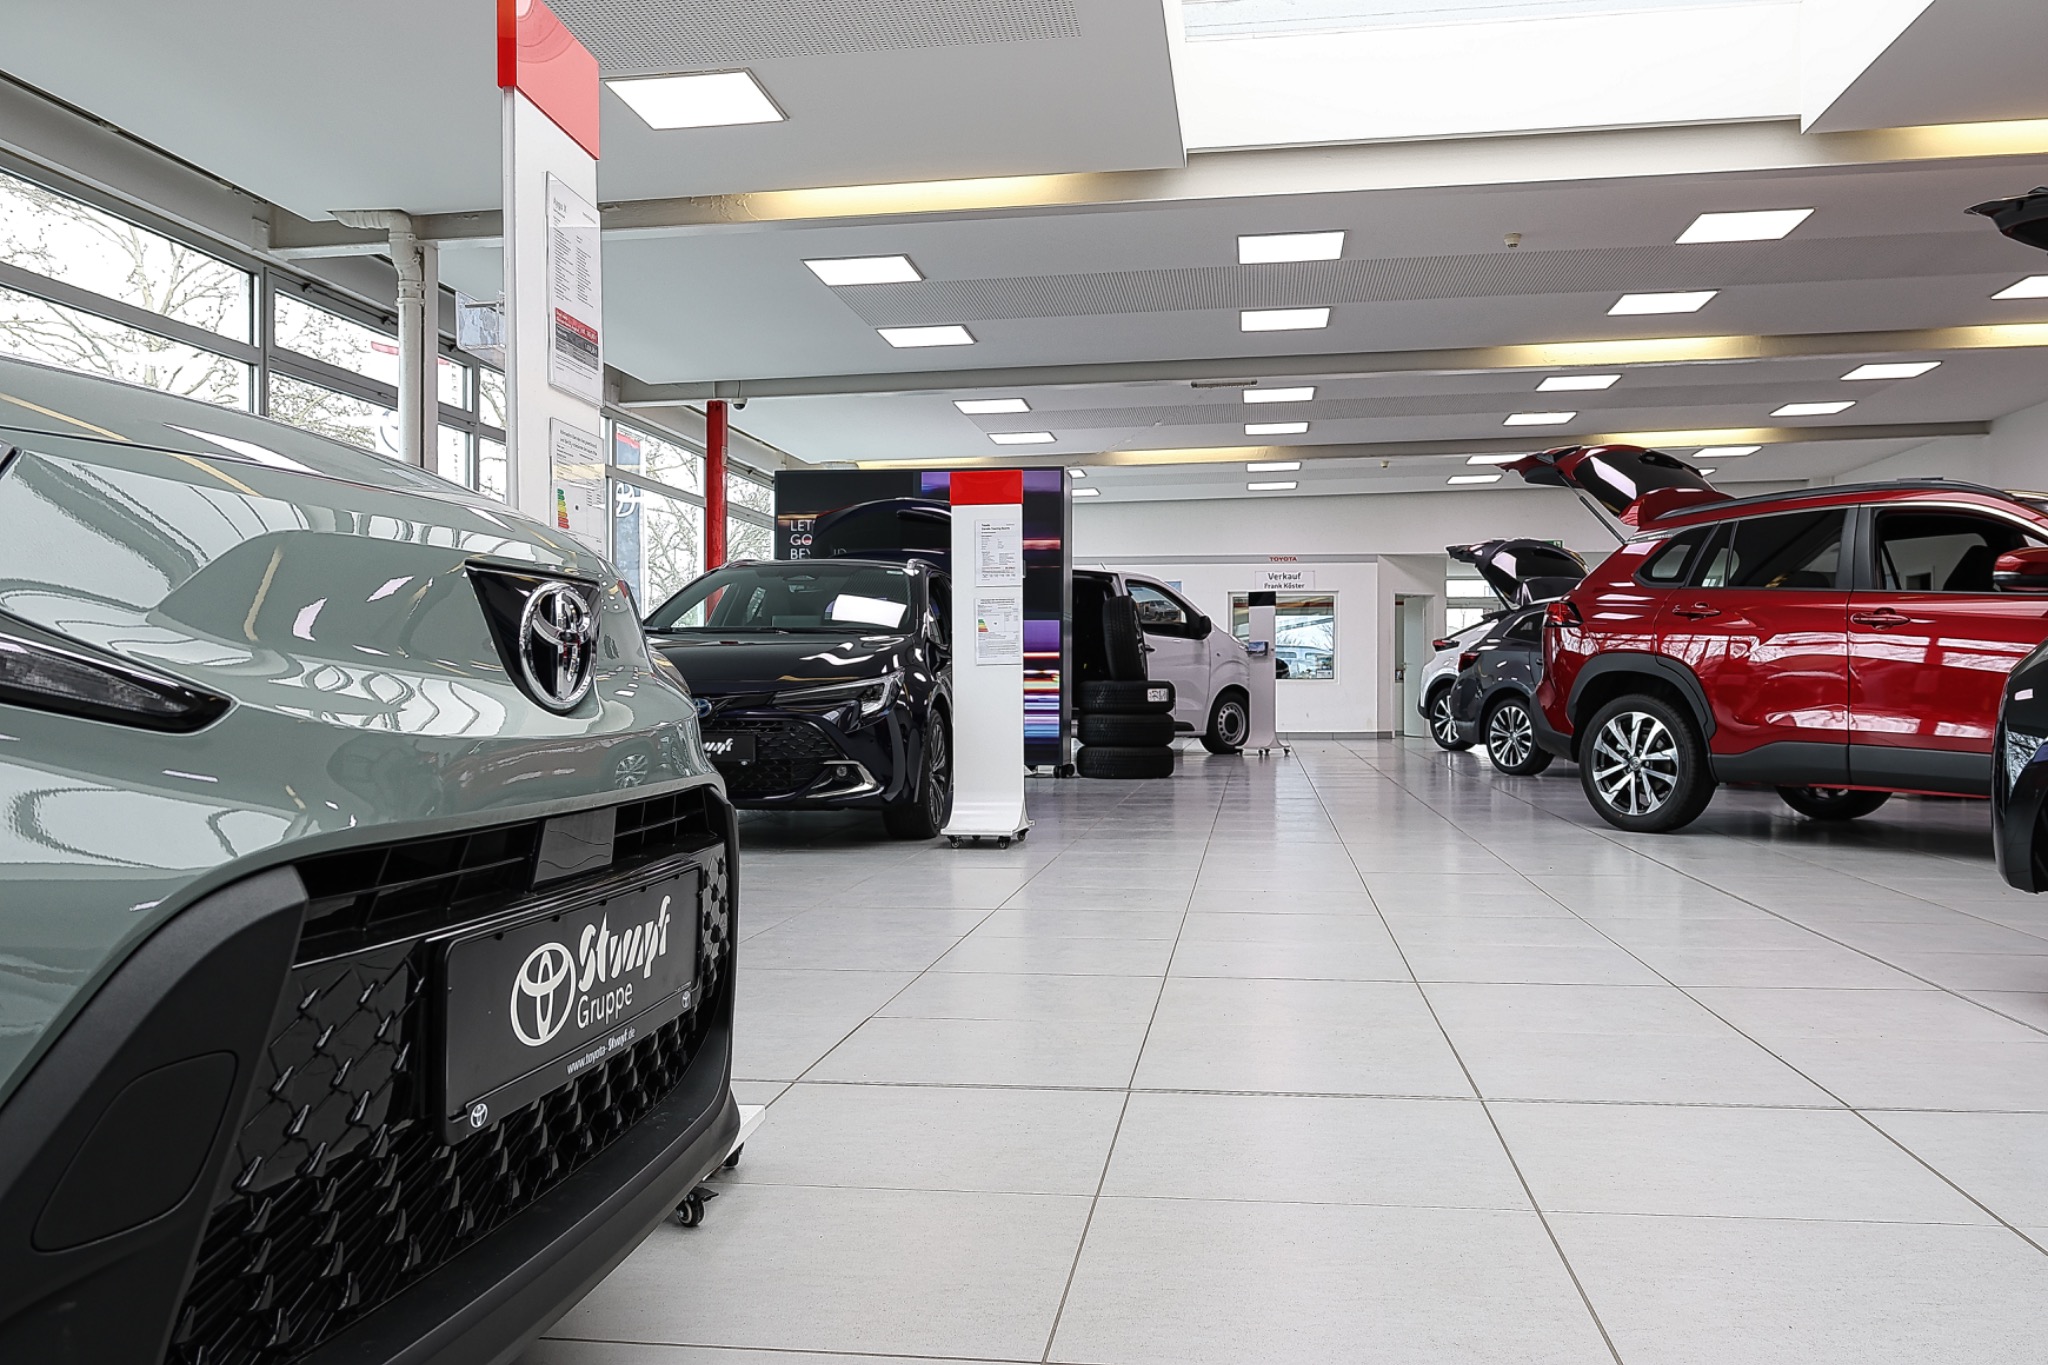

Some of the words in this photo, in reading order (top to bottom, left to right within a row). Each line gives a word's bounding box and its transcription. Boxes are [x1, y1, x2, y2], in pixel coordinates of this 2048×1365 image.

[790, 519, 816, 532] LET'
[790, 533, 813, 546] GO
[1267, 572, 1301, 580] Verkauf
[578, 895, 671, 992] Stumpf
[577, 982, 633, 1029] Gruppe
